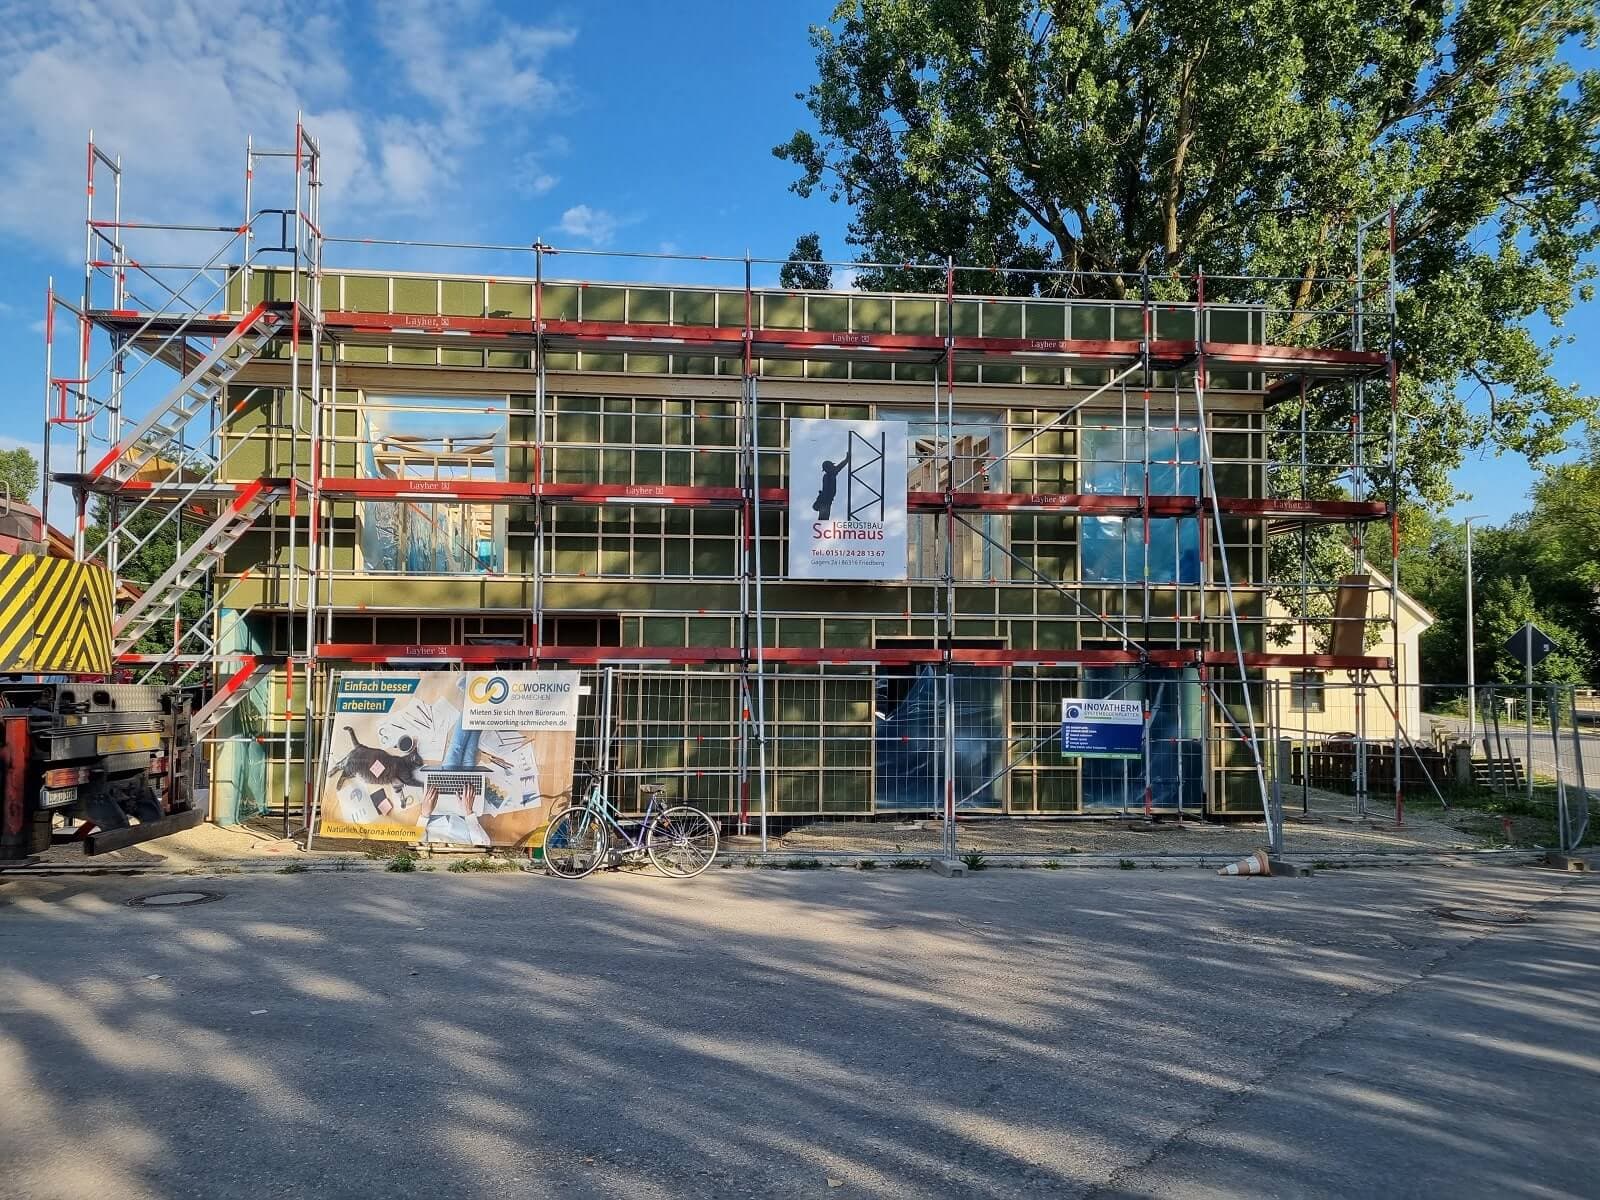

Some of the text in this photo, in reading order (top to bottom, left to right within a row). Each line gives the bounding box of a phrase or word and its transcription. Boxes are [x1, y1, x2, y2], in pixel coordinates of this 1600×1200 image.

[409, 481, 438, 491] Layher
[626, 486, 653, 496] Layher
[1031, 495, 1056, 505] Layher
[812, 522, 884, 540] Schmaus
[811, 549, 824, 557] Tel.
[406, 646, 436, 657] Layher
[344, 681, 413, 692] Einfach besser
[511, 683, 571, 693] COWORKING
[342, 699, 386, 711] arbeiten!
[1084, 703, 1139, 713] INOVATHERM
[469, 719, 567, 727] www.coworking-schmiechen.de
[326, 825, 416, 837] Natürlich Corona-konform
